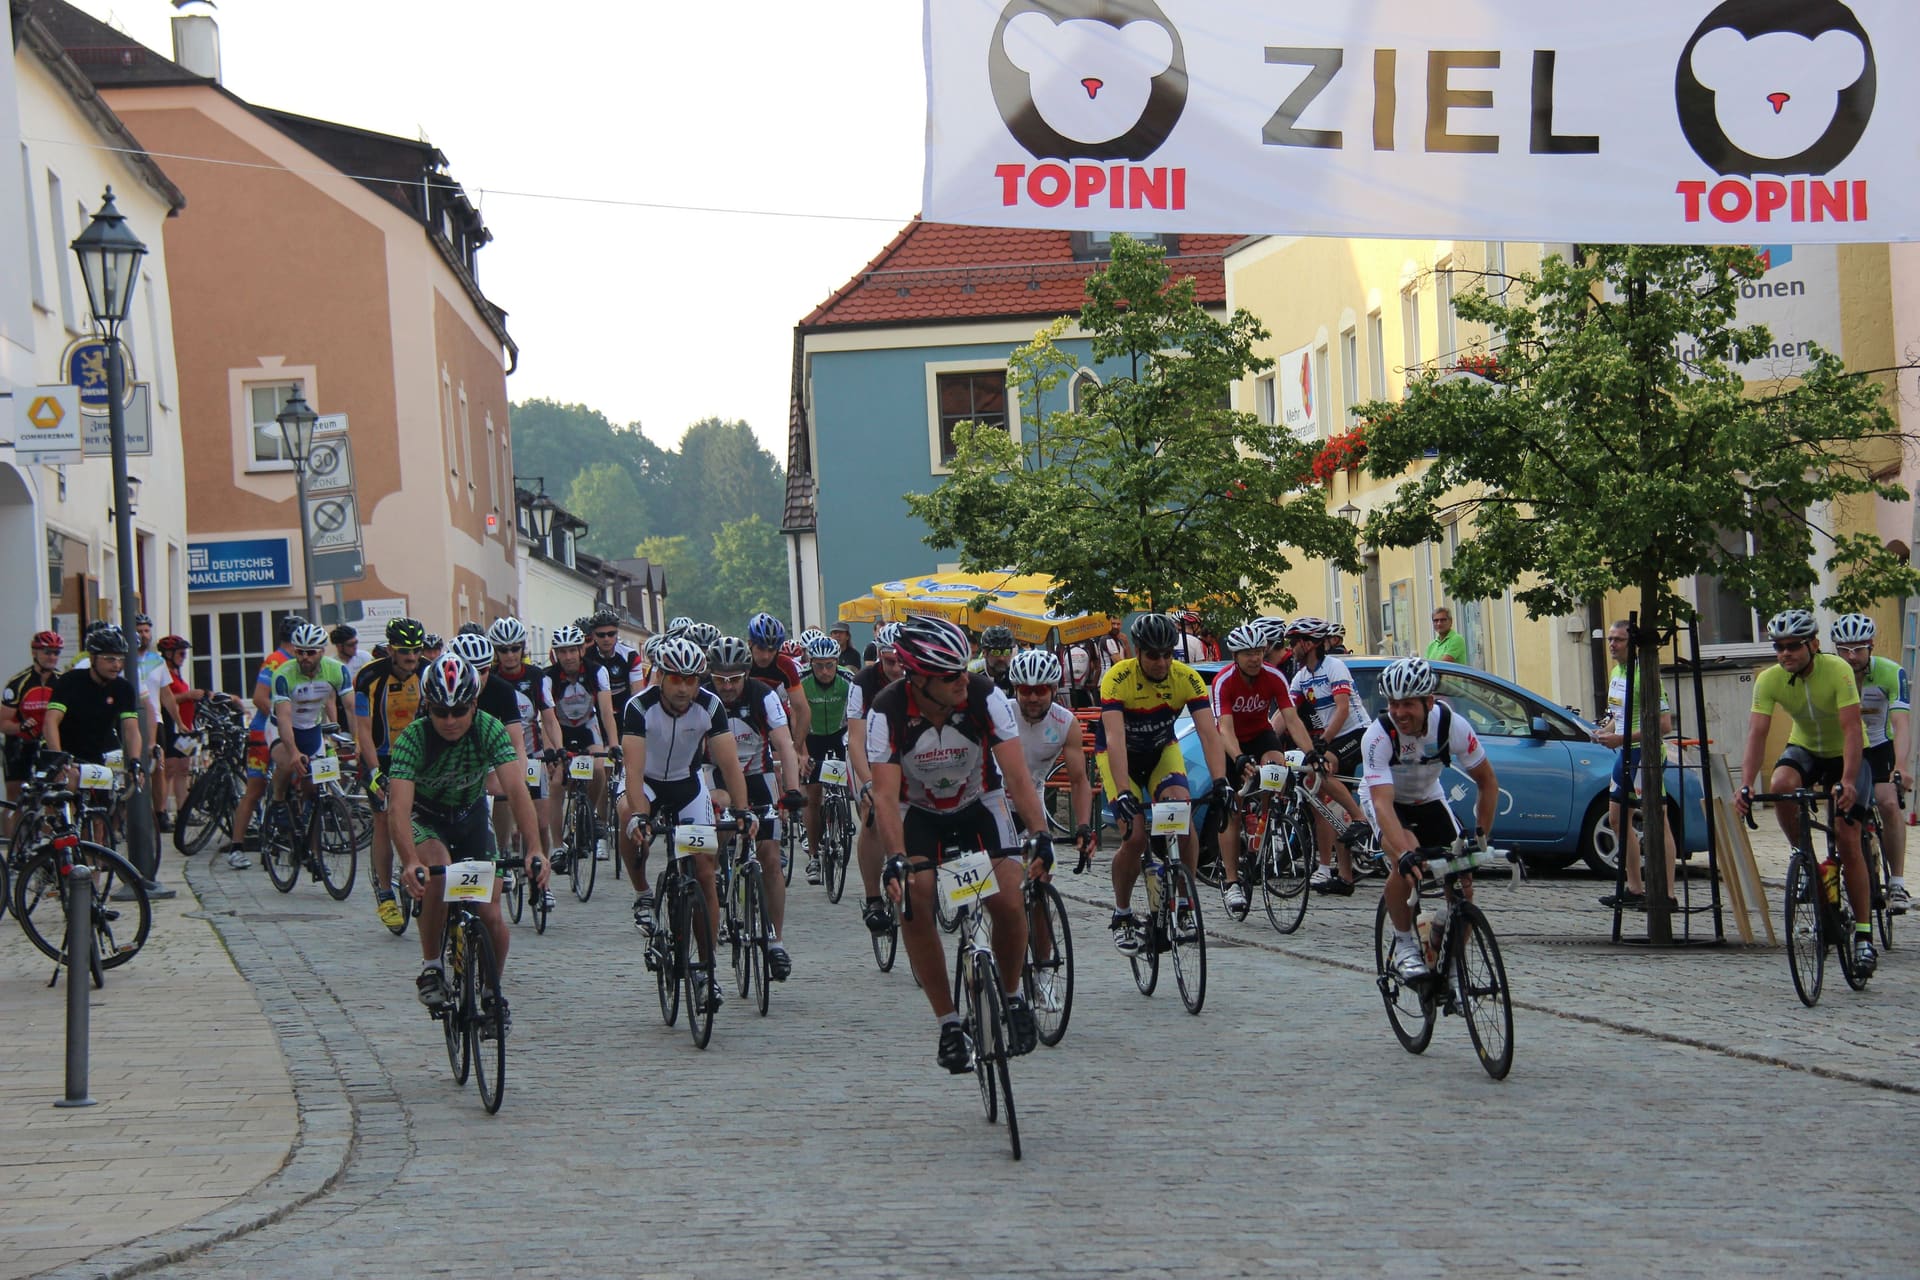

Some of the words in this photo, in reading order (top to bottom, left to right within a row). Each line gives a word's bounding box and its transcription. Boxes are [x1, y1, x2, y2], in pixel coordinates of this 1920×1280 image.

[1263, 47, 1600, 156] ZIEL
[995, 163, 1187, 211] TOPINI
[1676, 180, 1867, 223] TOPINI
[20, 432, 74, 441] COMMERZBANK
[313, 452, 334, 470] 30
[312, 477, 339, 488] ZONE
[320, 533, 346, 545] ZONE
[211, 557, 274, 571] DEUTSCHES
[188, 569, 275, 585] MAKLERFORUM
[1739, 675, 1752, 683] 66
[320, 765, 331, 773] 32
[576, 762, 590, 770] 134
[1270, 772, 1280, 781] 18
[1167, 813, 1175, 822] 4
[688, 836, 705, 847] 25
[460, 873, 479, 886] 24
[953, 868, 980, 888] 141
